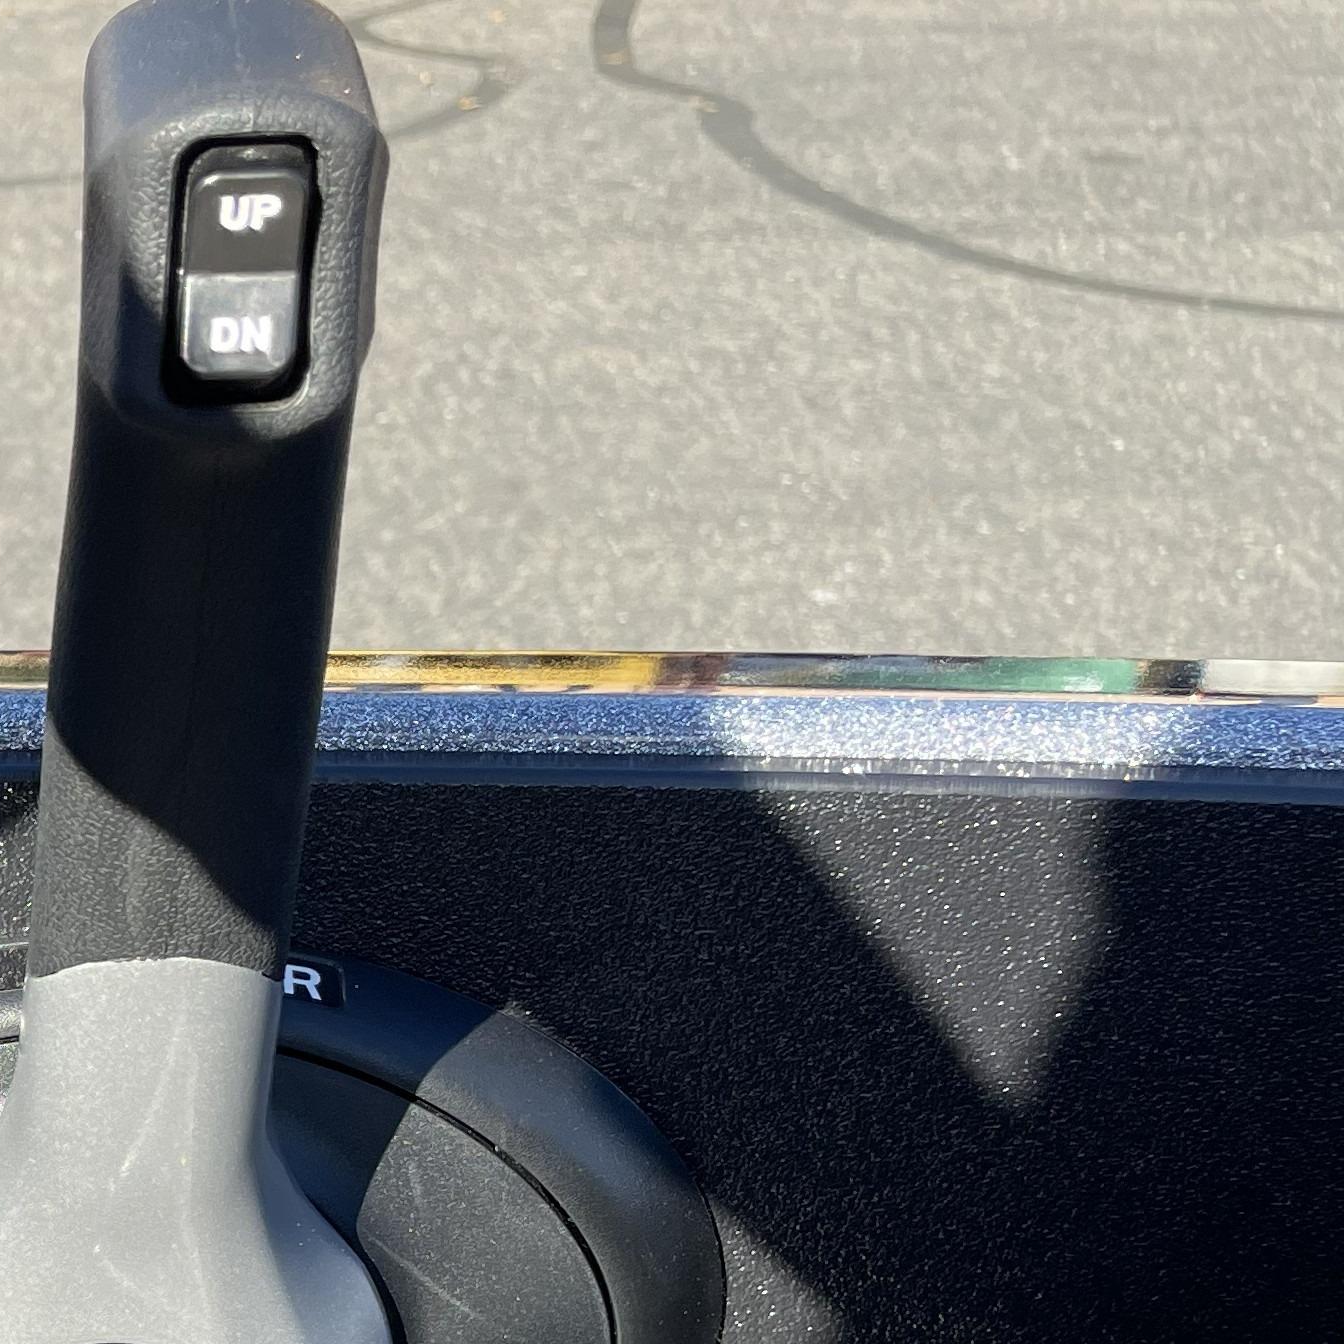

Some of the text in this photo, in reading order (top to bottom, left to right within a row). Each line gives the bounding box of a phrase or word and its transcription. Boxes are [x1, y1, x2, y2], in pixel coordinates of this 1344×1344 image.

[219, 194, 282, 231] UP
[211, 316, 271, 352] DN
[283, 964, 322, 1000] R
